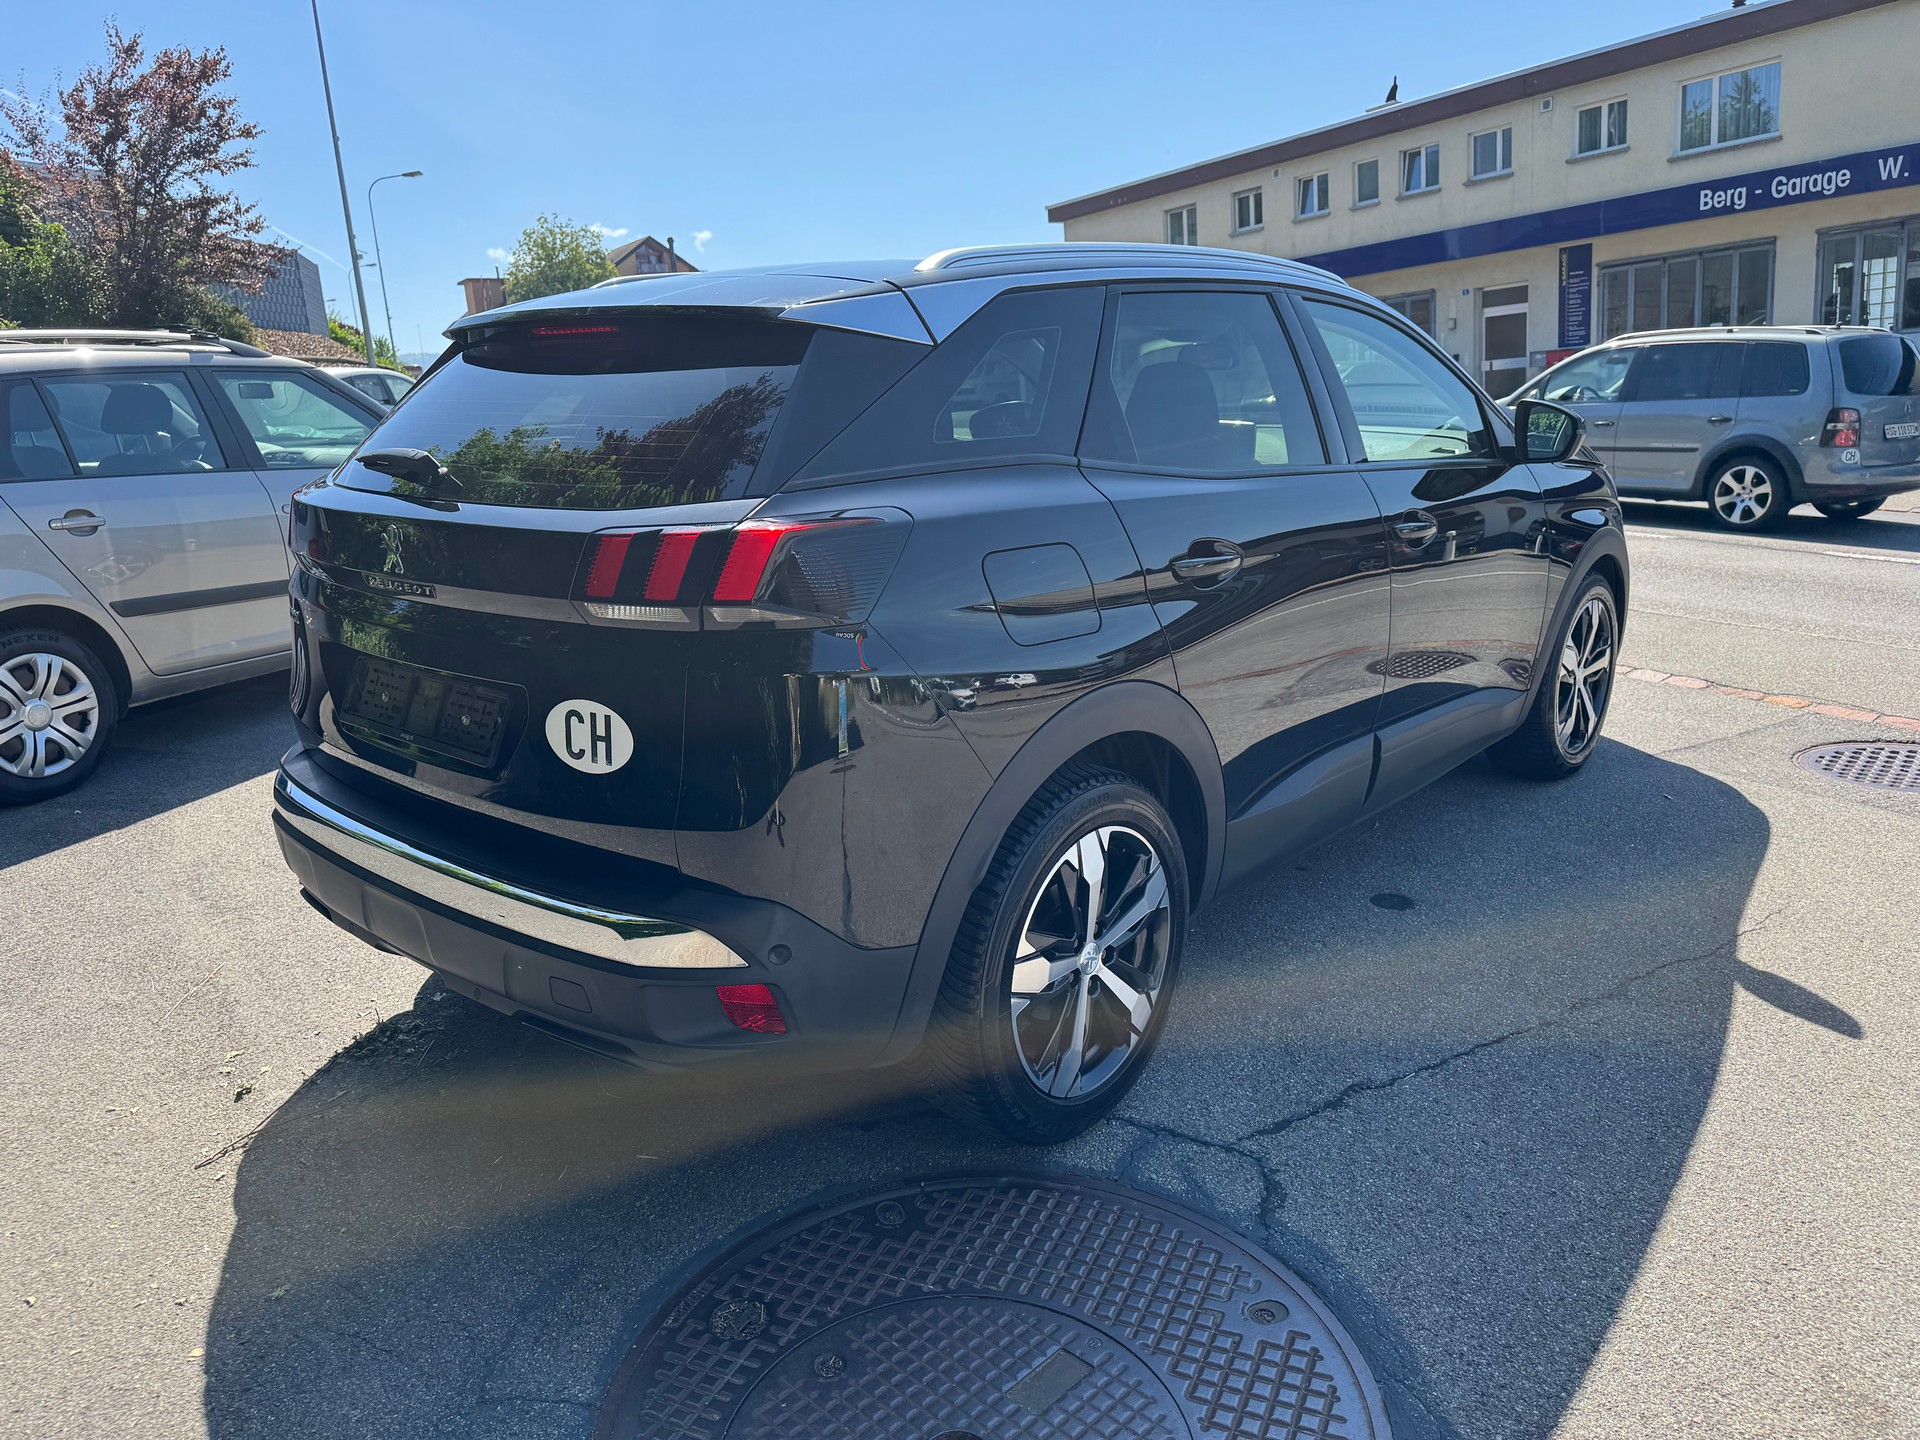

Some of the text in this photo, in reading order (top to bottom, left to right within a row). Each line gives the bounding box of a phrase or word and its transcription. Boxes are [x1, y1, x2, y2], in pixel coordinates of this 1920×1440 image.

[1699, 186, 1747, 211] Berg
[1771, 168, 1851, 200] Garage
[1878, 154, 1909, 181] W.
[1845, 451, 1856, 461] CH
[368, 576, 432, 596] PEUGEOT
[0, 633, 59, 649] NEXEN
[564, 708, 613, 766] CH
